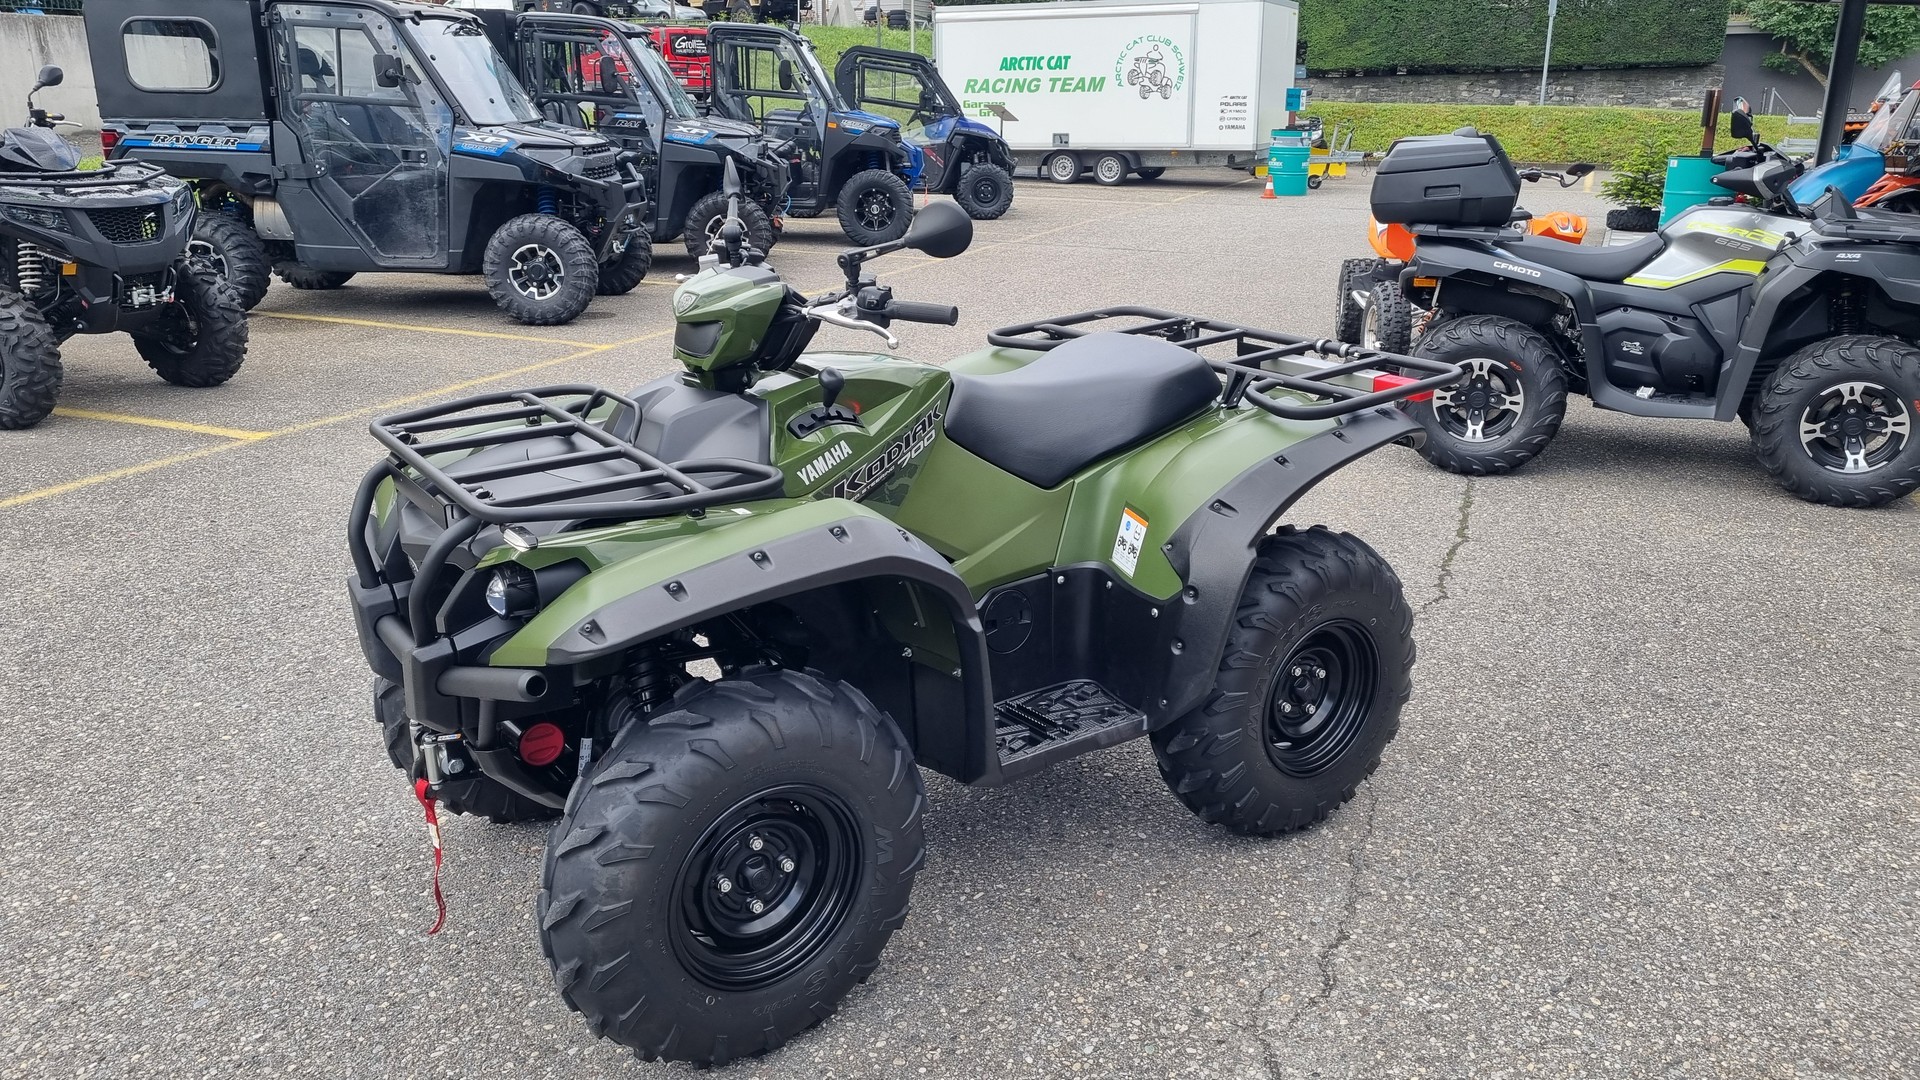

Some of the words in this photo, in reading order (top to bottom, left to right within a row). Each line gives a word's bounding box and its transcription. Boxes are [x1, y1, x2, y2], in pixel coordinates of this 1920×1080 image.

[999, 56, 1045, 71] ARCTIC
[1047, 55, 1071, 70] CAT
[1115, 51, 1127, 87] ARCTIC
[1126, 36, 1144, 51] CAT
[1146, 35, 1172, 47] CLUB
[1171, 45, 1185, 91] SCHWEIZ
[964, 77, 1042, 94] RACING
[1049, 76, 1106, 93] TEAM
[459, 132, 508, 144] XP
[671, 125, 709, 134] XP
[152, 134, 239, 147] RANGER
[1686, 221, 1785, 246] CFORCE
[1714, 237, 1753, 252] 625
[1493, 260, 1541, 278] CFMOTO
[833, 400, 944, 500] KODIAK
[897, 428, 936, 469] 700
[796, 439, 853, 486] YAMAHA
[803, 824, 896, 998] MAXXIS
